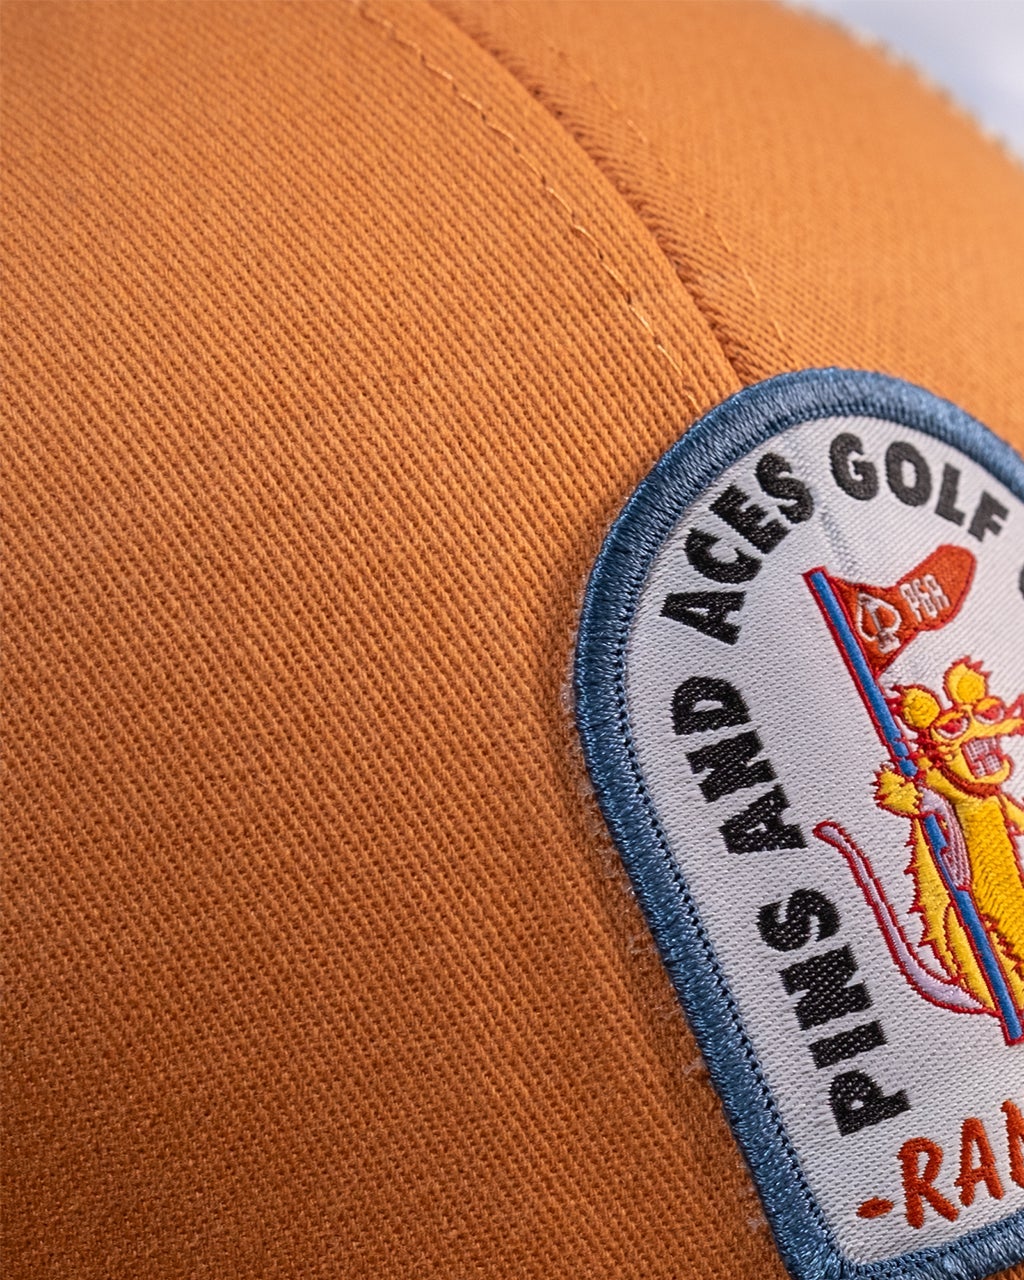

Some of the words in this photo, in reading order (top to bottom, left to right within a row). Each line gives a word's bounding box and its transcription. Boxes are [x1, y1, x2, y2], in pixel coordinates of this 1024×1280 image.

[658, 452, 815, 646] ACES
[829, 432, 1009, 543] GOLF
[669, 675, 809, 856] AND
[754, 887, 912, 1138] PINS
